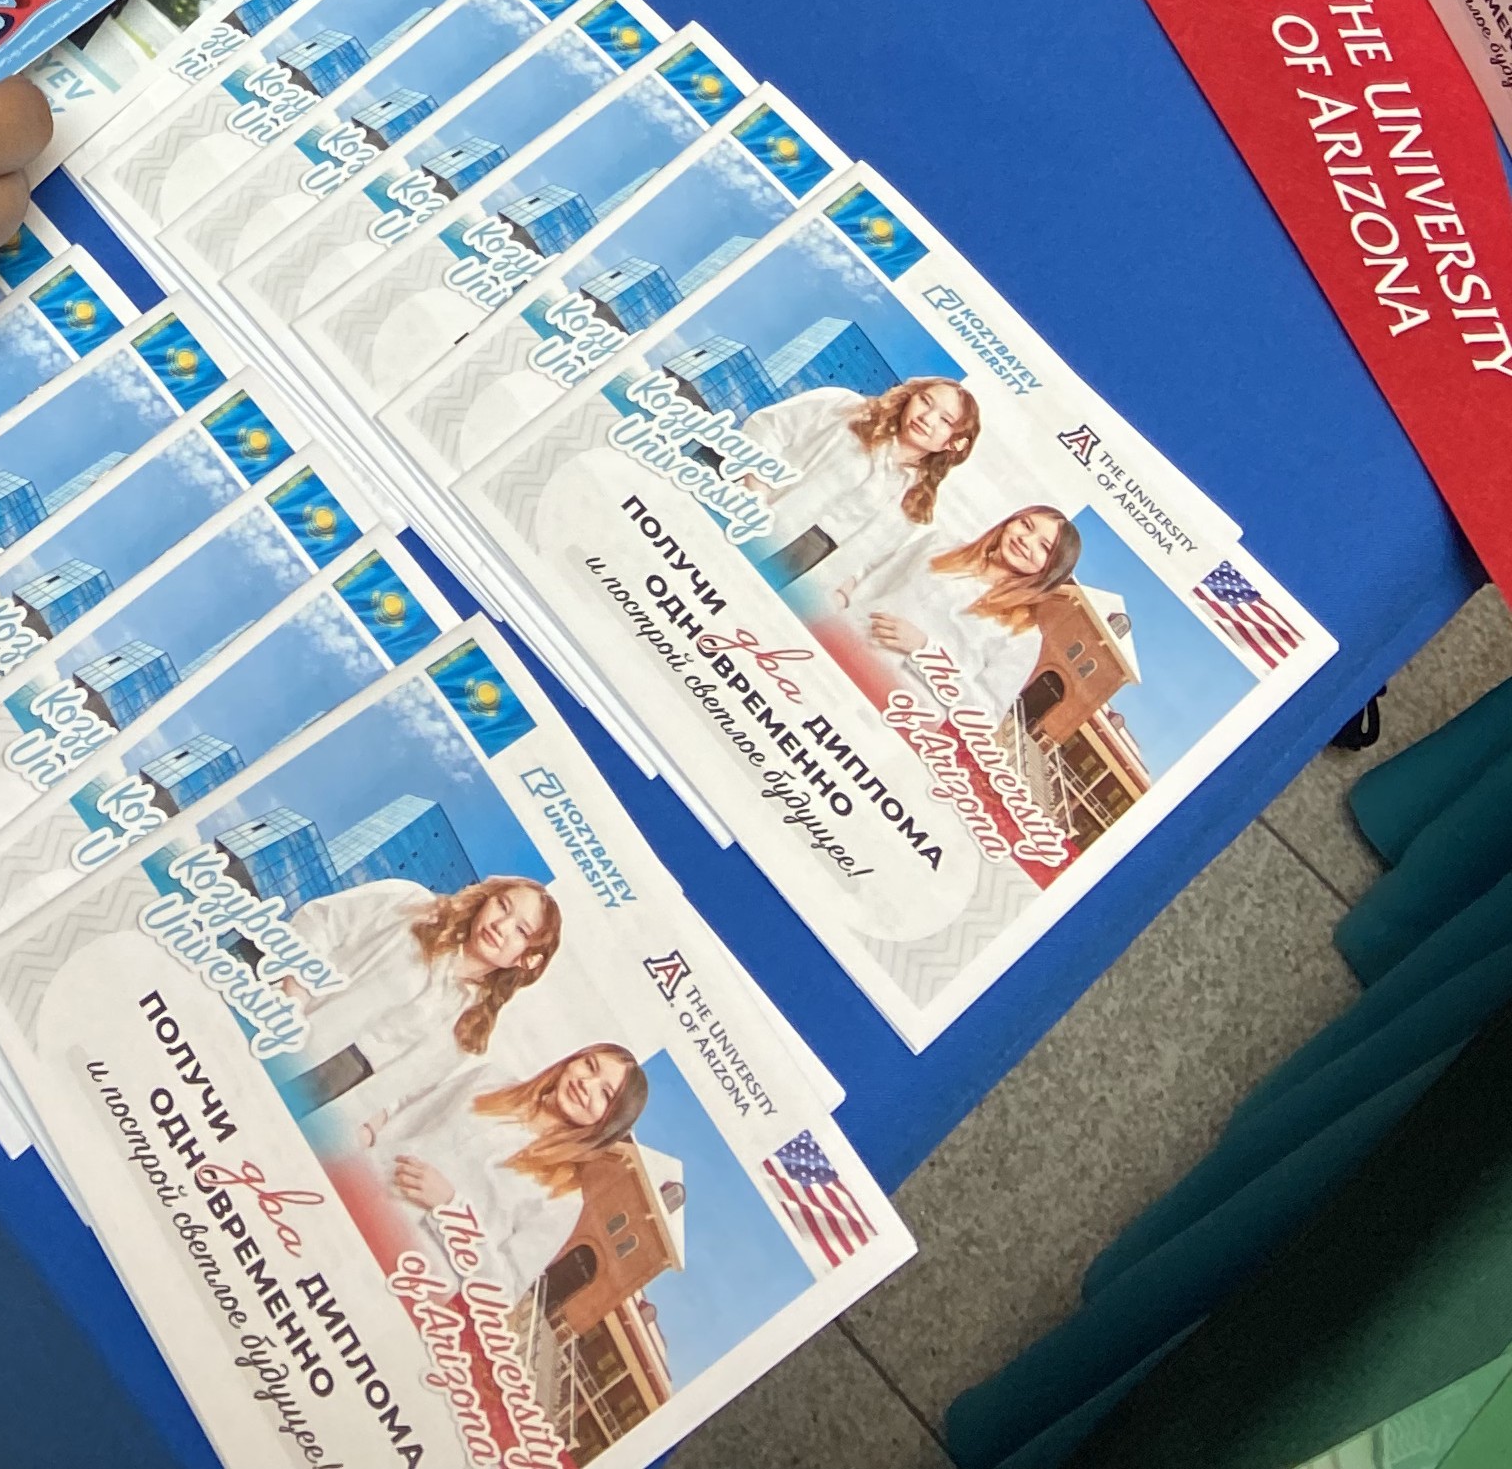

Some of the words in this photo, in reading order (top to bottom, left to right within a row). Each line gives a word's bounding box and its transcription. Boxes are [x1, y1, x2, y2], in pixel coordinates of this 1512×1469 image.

[1271, 14, 1332, 77] OF
[1297, 88, 1430, 338] ARIZONA
[1364, 82, 1512, 376] UNIVERSITY
[948, 315, 1030, 396] UNIVERSITY
[960, 307, 1043, 391] KOZYBAYEV
[614, 413, 770, 541] University
[632, 373, 798, 484] Kozybayev
[1097, 473, 1118, 496] OF
[1114, 492, 1174, 555] ARIZONA
[1100, 450, 1127, 482] THE
[1125, 478, 1198, 553] UNIVERSITY
[587, 557, 601, 574] и
[602, 574, 686, 673] построй
[685, 673, 766, 768] светлое
[762, 768, 874, 878] будущее!
[621, 494, 727, 616] ПОЛУЧИ
[698, 629, 814, 704] два
[802, 713, 944, 871] ДИПЛОМА
[645, 574, 853, 816] ОДНОВРЕМЕННО
[887, 694, 936, 725] of
[914, 734, 1007, 858] Arizona
[916, 646, 960, 699] The
[952, 709, 1067, 864] University
[544, 806, 621, 908] UNIVERSITY
[561, 798, 638, 902] KOZYBAYEV
[144, 898, 303, 1052] University
[175, 849, 344, 992] Kozybayev
[679, 1011, 699, 1040] OF
[695, 1038, 750, 1117] ARIZONA
[686, 984, 714, 1023] THE
[710, 1021, 778, 1117] UNIVERSITY
[139, 991, 238, 1142] ПОЛУЧИ
[196, 1160, 324, 1257] два
[87, 1061, 105, 1083] и
[102, 1086, 187, 1206] построй
[174, 1207, 248, 1329] светлое
[150, 1088, 335, 1398] ОДНОВРЕМЕННО
[439, 1205, 484, 1269] The
[392, 1256, 448, 1293] of
[417, 1303, 499, 1467] Arizona
